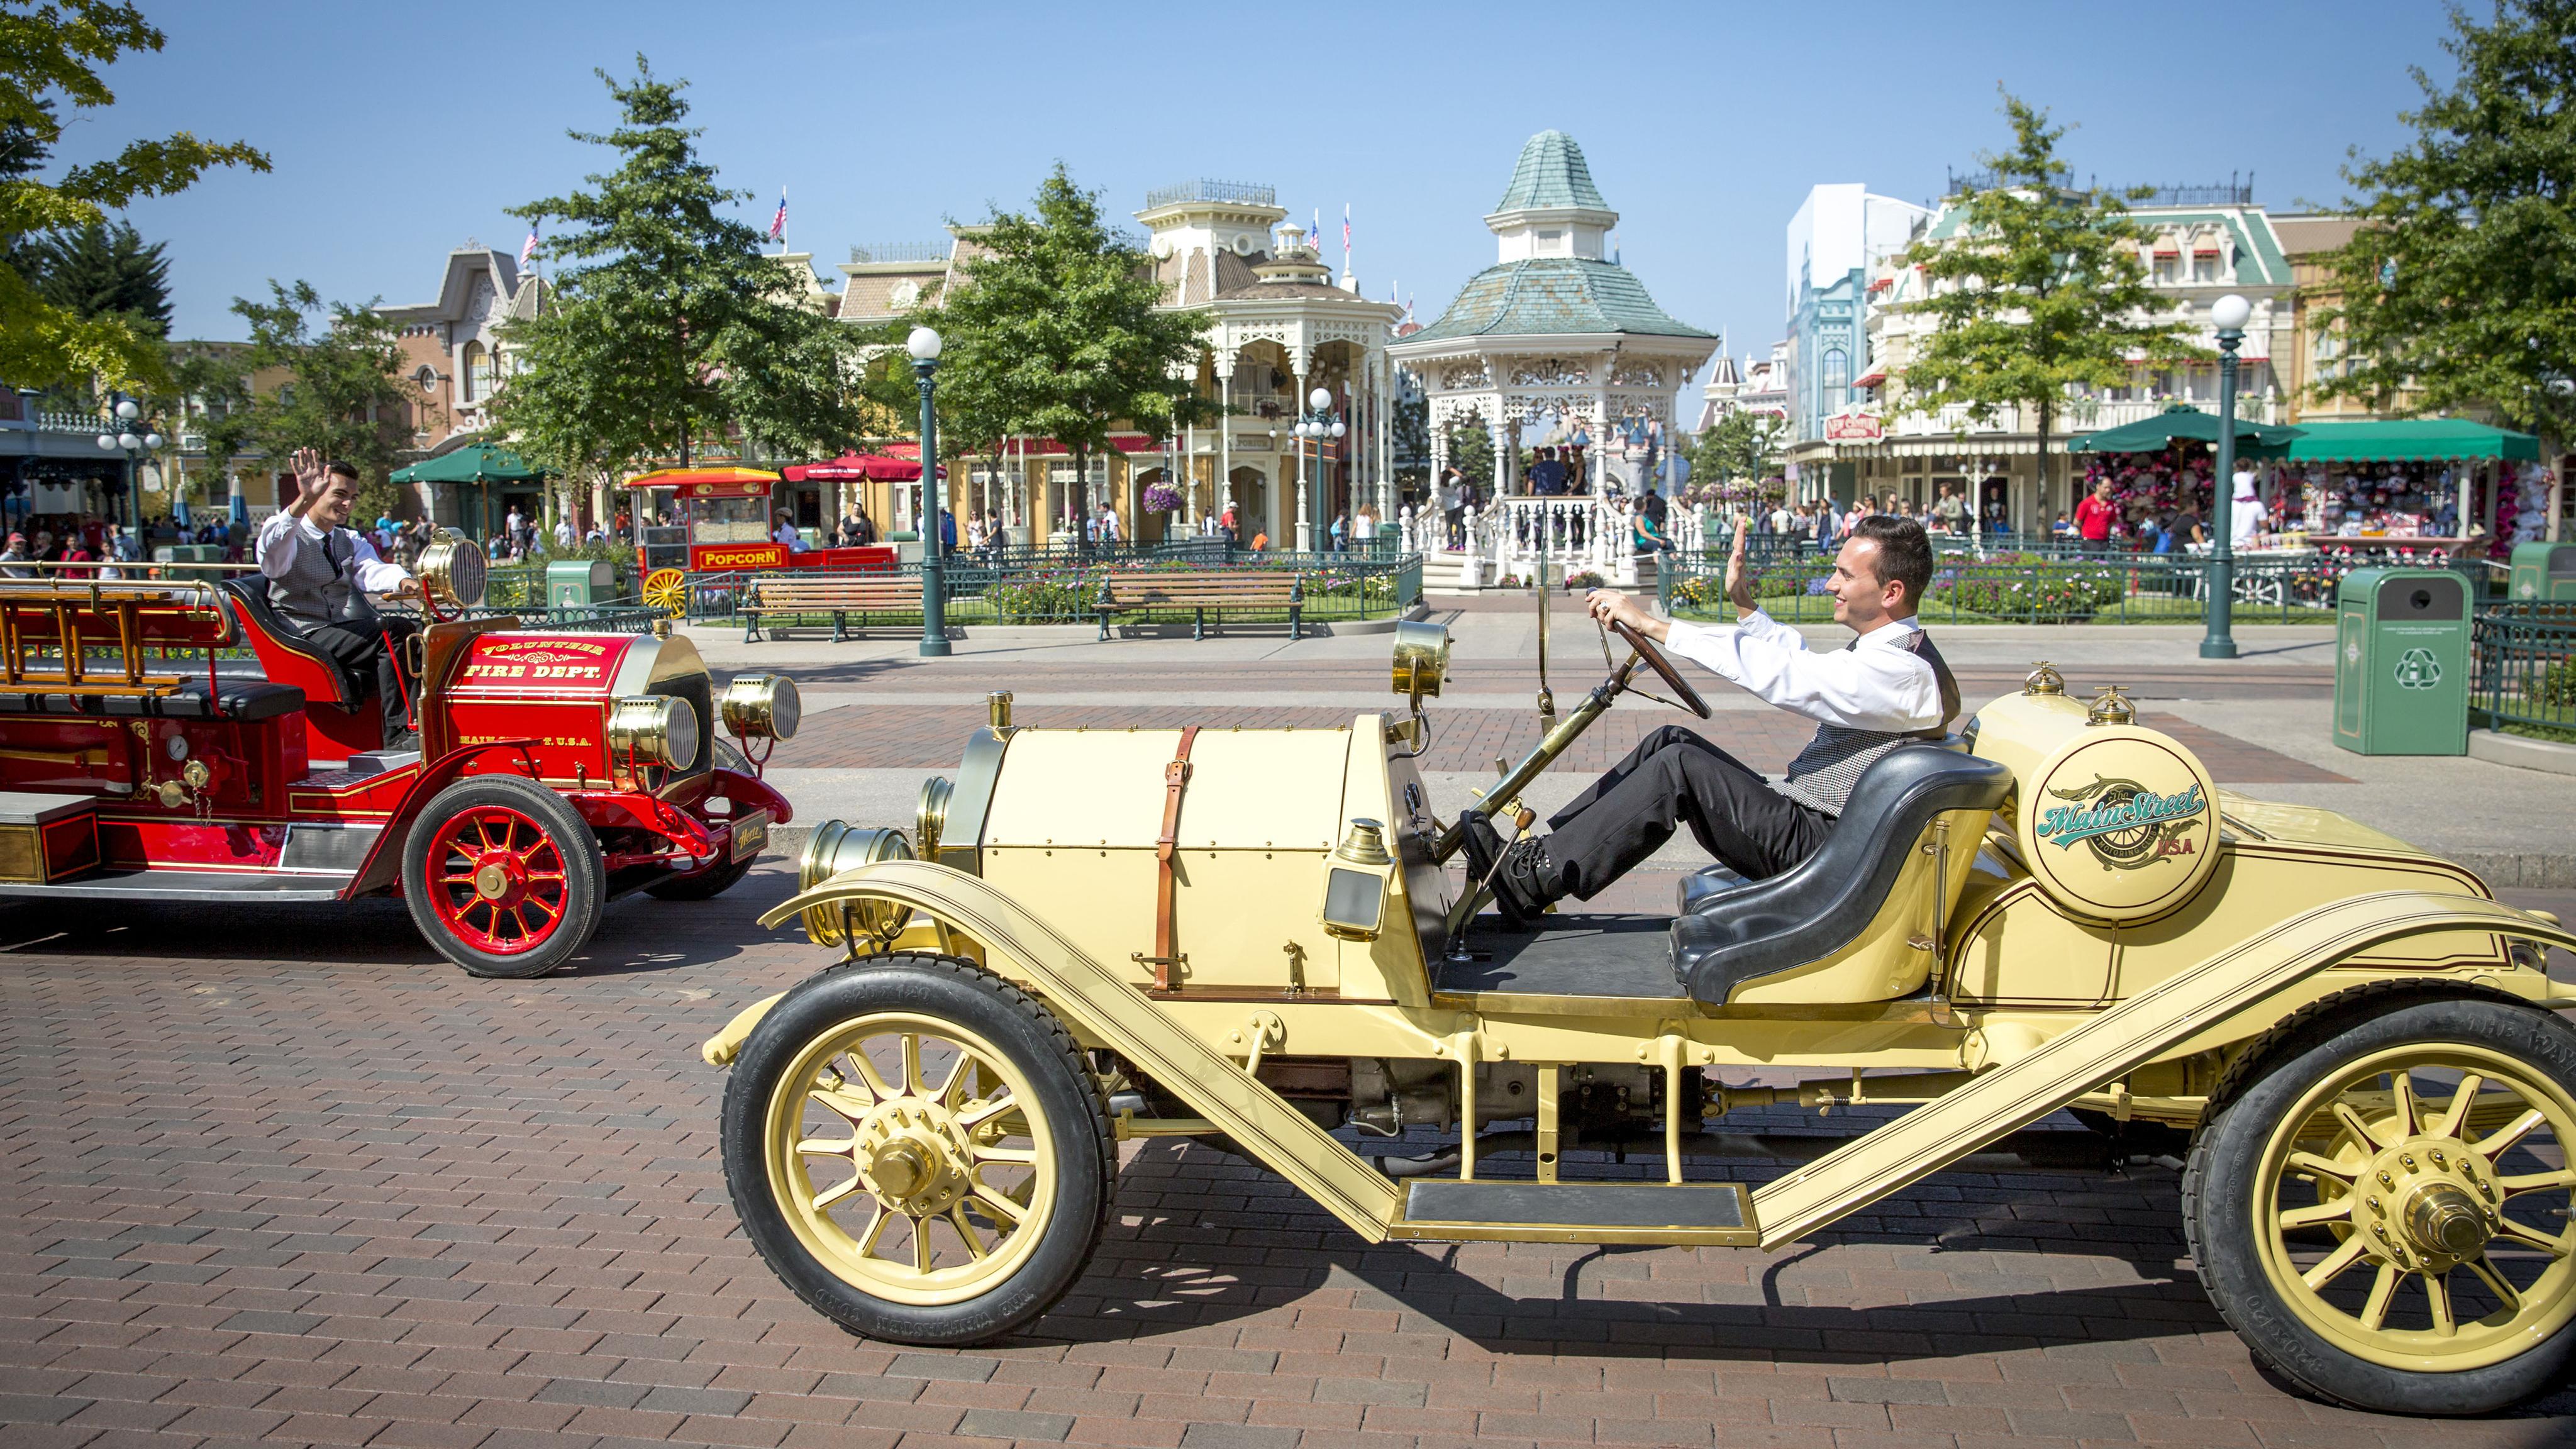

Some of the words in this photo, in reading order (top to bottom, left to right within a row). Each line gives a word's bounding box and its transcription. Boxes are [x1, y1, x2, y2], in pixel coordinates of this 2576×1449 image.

[705, 551, 776, 565] POPCORN
[482, 641, 606, 656] VOLUNTEER
[464, 665, 526, 678] FIRE
[533, 666, 601, 679] DEPT.
[556, 737, 592, 747] U.S.A.
[2108, 790, 2129, 802] The
[738, 826, 762, 850] Hertz
[2097, 841, 2140, 857] MOTORING
[2141, 830, 2158, 850] CLUB
